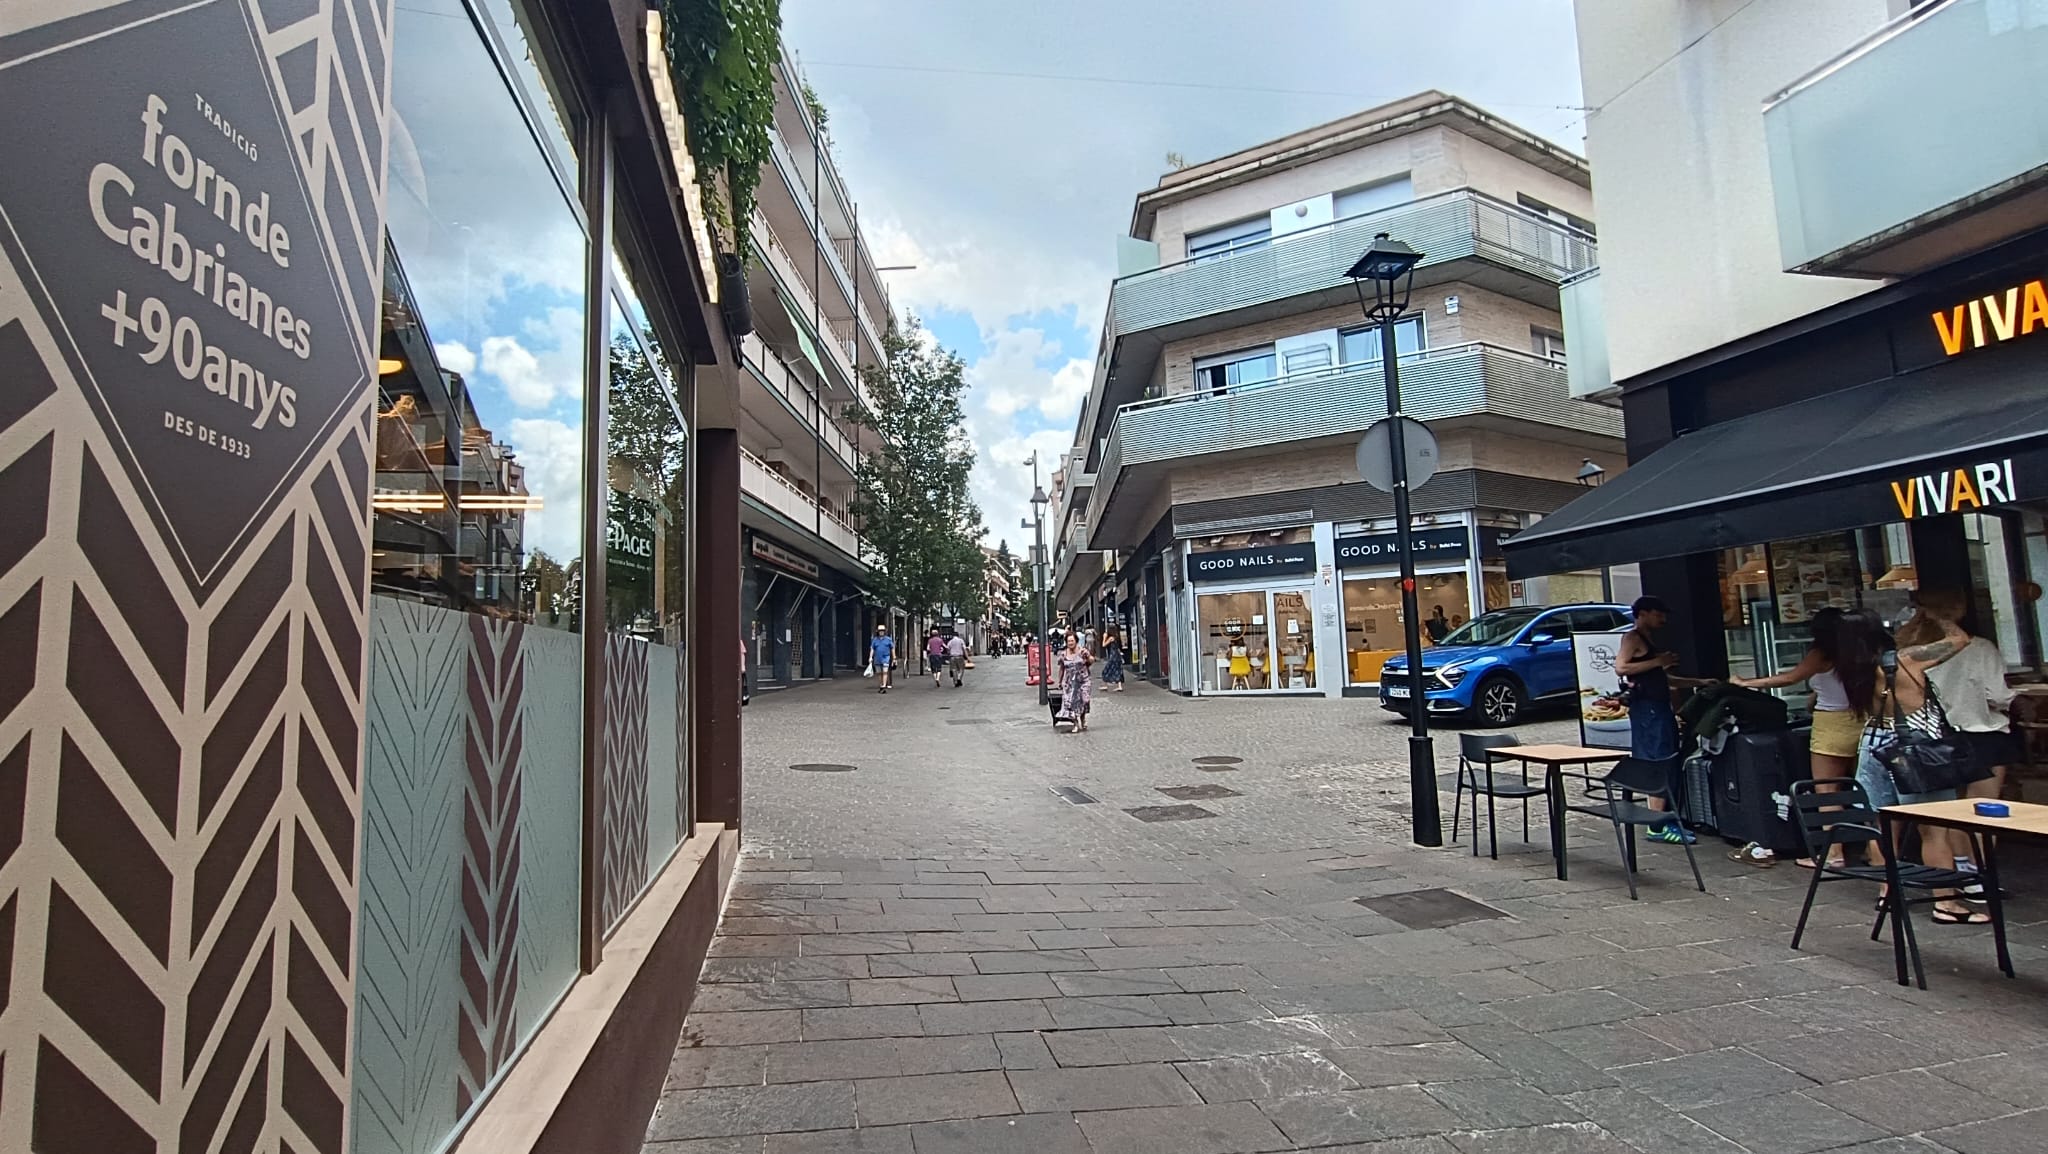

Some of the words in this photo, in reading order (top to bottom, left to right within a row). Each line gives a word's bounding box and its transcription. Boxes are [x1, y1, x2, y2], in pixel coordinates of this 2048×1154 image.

[195, 92, 258, 162] TRADICIÓ
[88, 162, 311, 360] Cabrianes
[164, 411, 194, 437] DES
[198, 425, 217, 446] DE
[221, 435, 251, 459] 1933
[1890, 458, 2017, 519] VIVARI
[1199, 558, 1234, 570] GOOD
[1239, 554, 1274, 567] NAILS
[1340, 544, 1381, 557] GOOD
[1386, 540, 1427, 553] NLS
